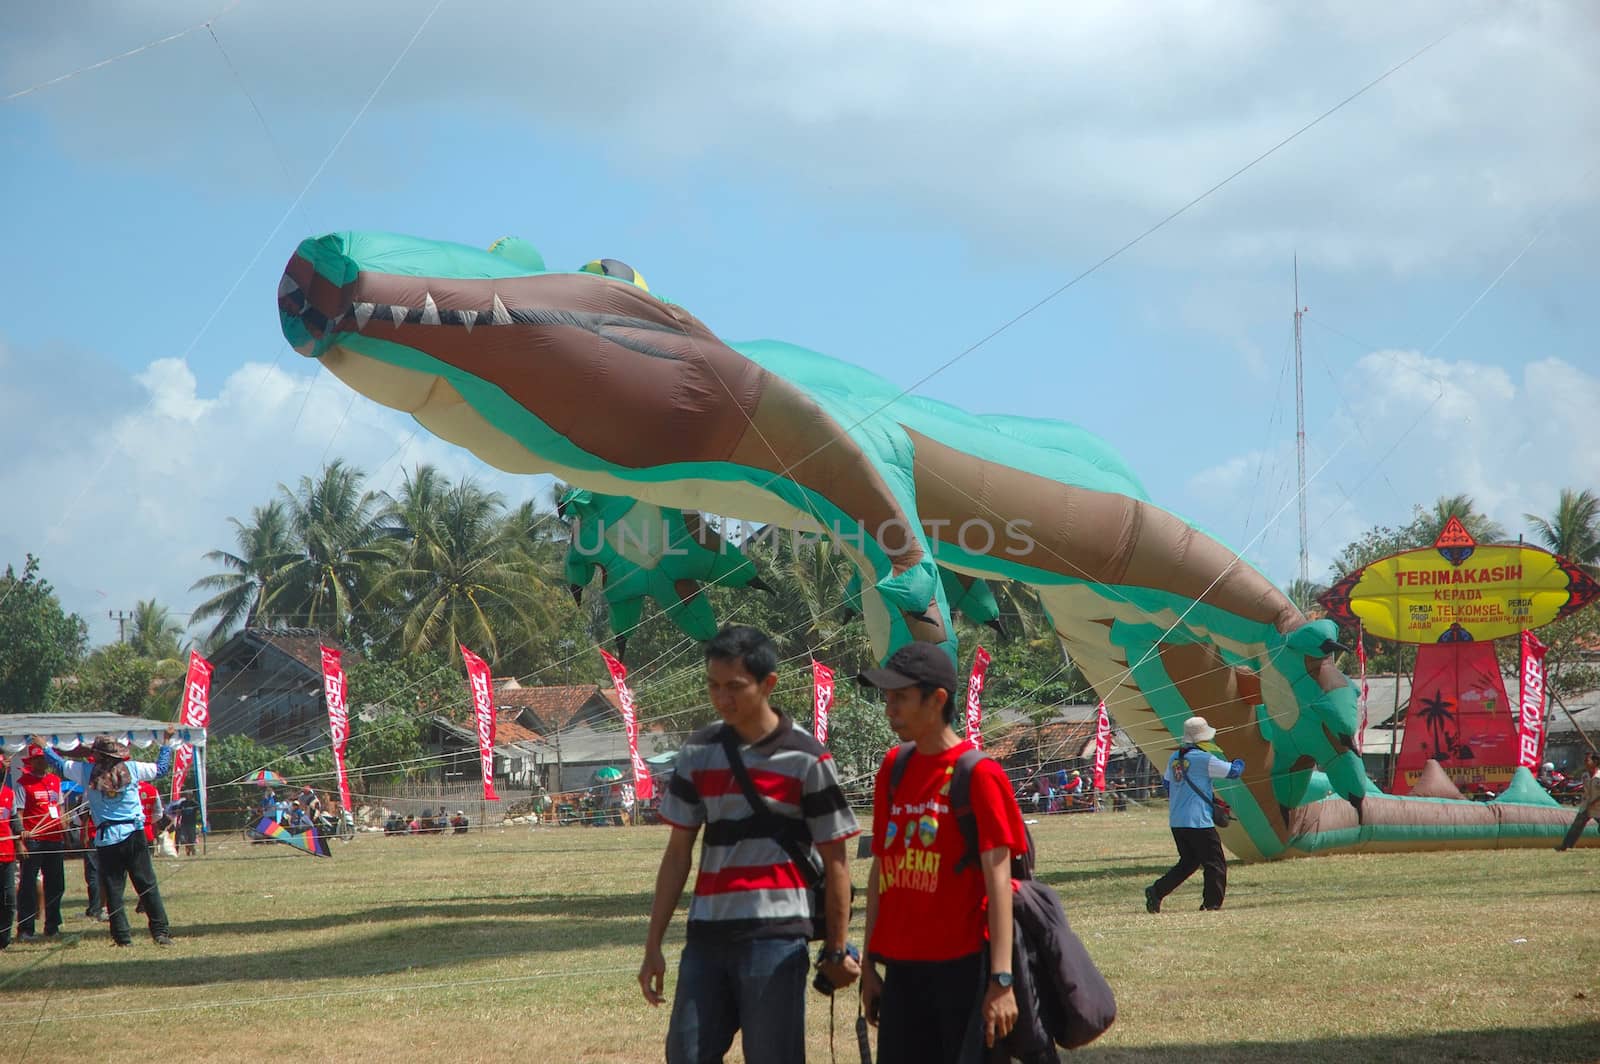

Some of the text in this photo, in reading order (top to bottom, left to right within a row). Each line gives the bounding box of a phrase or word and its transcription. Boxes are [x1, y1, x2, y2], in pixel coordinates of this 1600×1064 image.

[1395, 565, 1522, 587] TERIMAKASIH
[1434, 589, 1482, 600] KEPADA
[1437, 604, 1504, 616] TELKOMSEL
[1520, 655, 1543, 767] TELKOMSEL
[472, 672, 492, 785] TELKOMSEL
